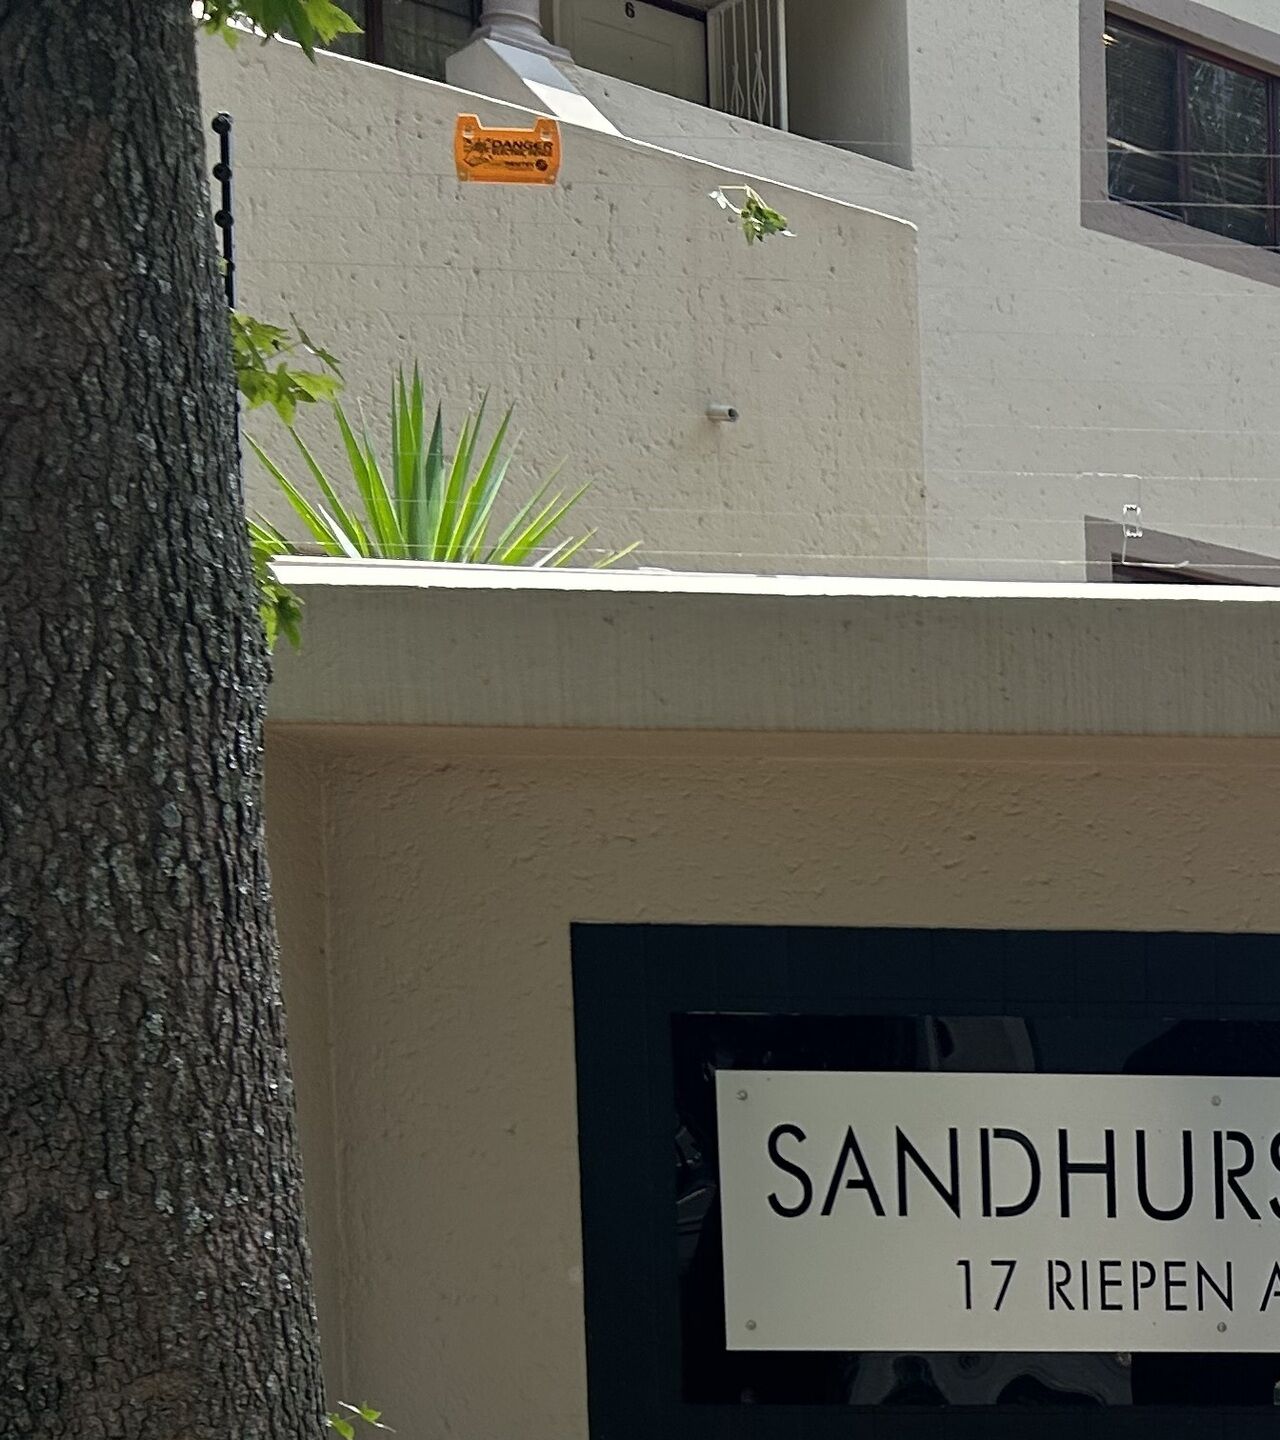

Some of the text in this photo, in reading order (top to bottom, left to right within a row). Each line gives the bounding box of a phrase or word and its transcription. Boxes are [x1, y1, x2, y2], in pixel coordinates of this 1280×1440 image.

[625, 2, 635, 19] 6
[492, 140, 553, 150] DANGER
[955, 1258, 1016, 1312] 17
[1046, 1259, 1234, 1312] RIEPEN
